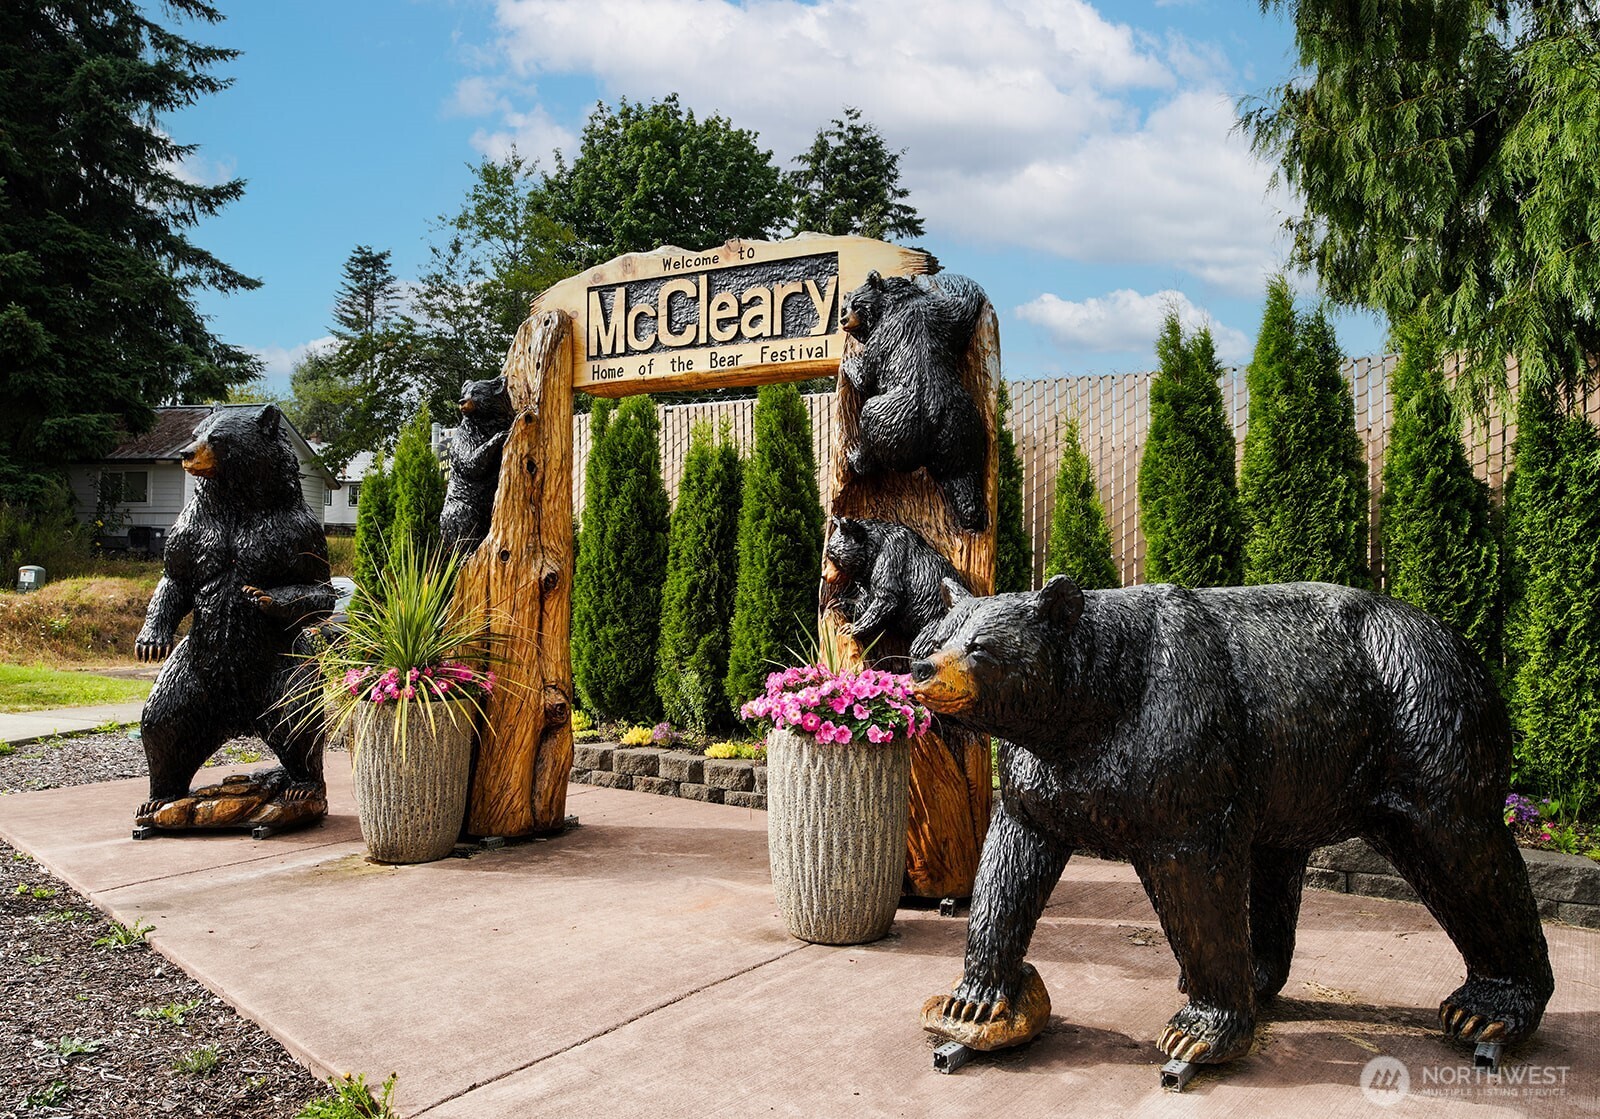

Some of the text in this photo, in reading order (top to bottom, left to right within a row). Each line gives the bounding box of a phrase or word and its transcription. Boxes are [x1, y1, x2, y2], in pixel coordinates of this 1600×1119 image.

[663, 246, 755, 271] Welcome to
[588, 274, 838, 357] McCleary
[592, 340, 828, 380] Home of the Bear Festival
